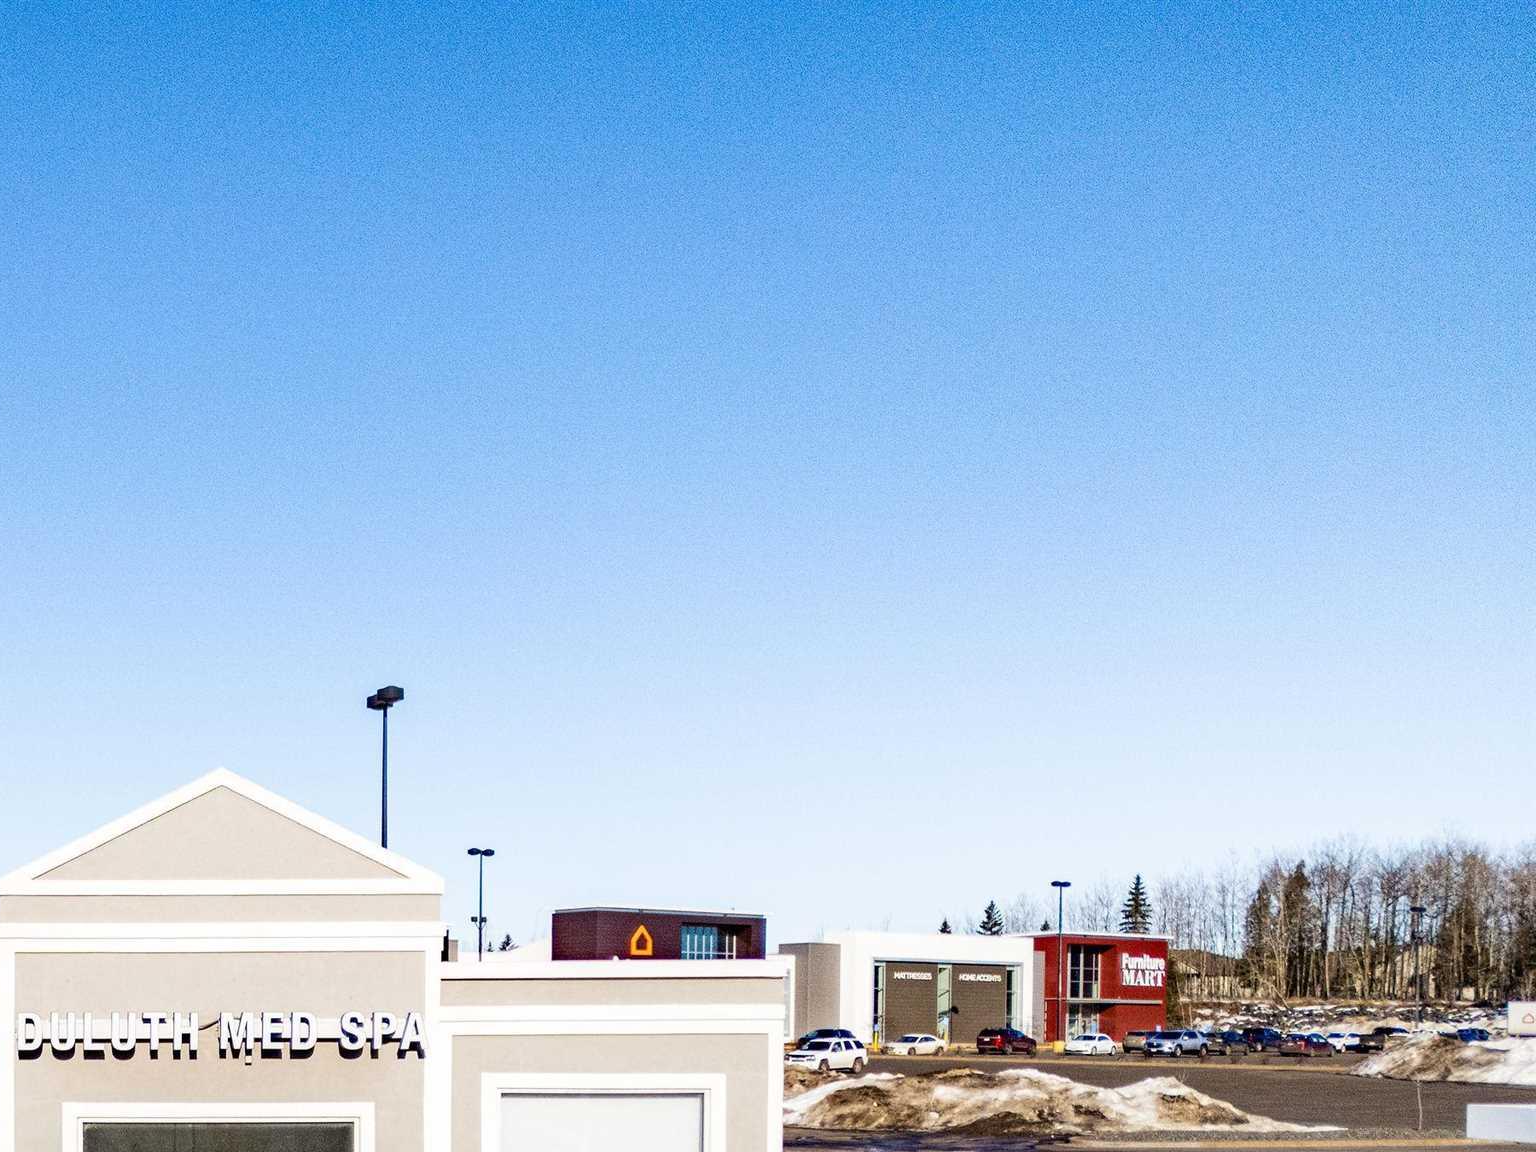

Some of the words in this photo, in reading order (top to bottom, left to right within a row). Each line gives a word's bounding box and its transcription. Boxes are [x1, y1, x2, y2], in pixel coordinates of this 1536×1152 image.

[1121, 953, 1166, 970] Furniture
[1122, 969, 1166, 987] MART
[17, 1011, 199, 1059] DULUTH
[219, 1011, 318, 1059] MED
[340, 1011, 429, 1058] SPA
